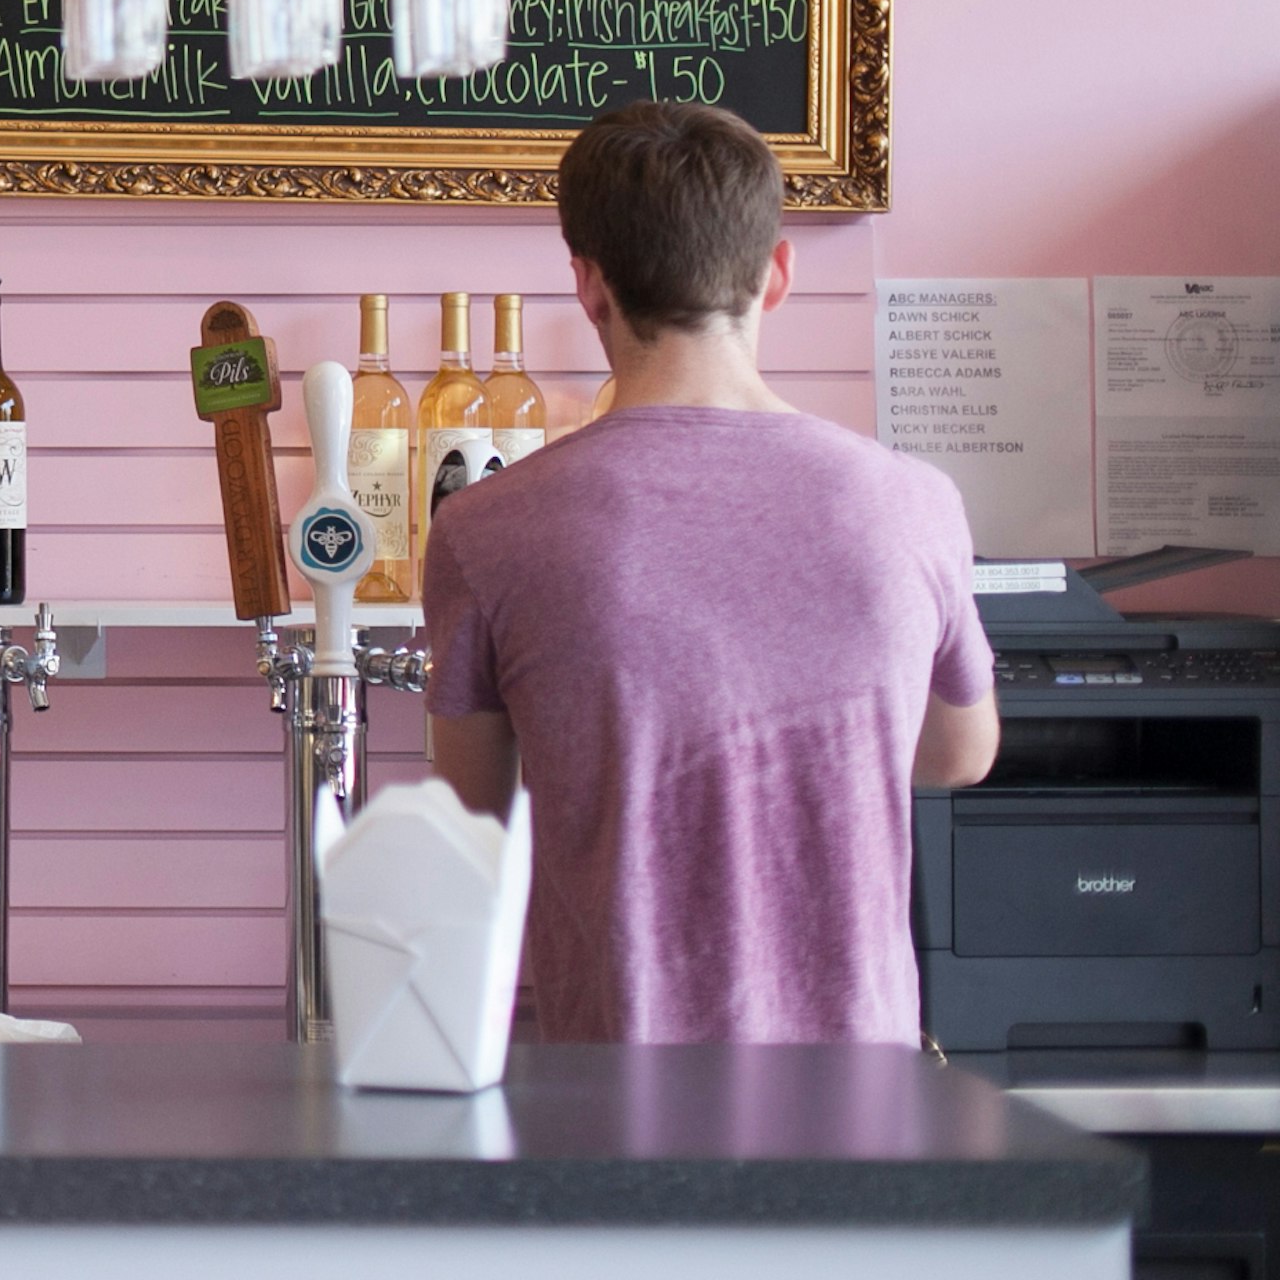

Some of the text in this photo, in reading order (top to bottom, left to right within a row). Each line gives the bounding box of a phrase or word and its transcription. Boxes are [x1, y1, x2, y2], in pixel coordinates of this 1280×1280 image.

[888, 293, 916, 304] ABC
[888, 312, 980, 322] DAWN SCHICK
[889, 330, 992, 341] ALBERT SCHICK
[889, 349, 996, 360] JESSYE VALERIE
[209, 356, 250, 386] Pils
[890, 367, 1002, 378] REBECCA ADAMS
[890, 386, 967, 397] SARA WAHL
[891, 405, 998, 416] CHRISTINA ELLIS
[891, 423, 986, 434] VICKY BECKER
[892, 442, 1024, 453] ASHLEE ALBERTSON
[1077, 875, 1137, 893] brother
